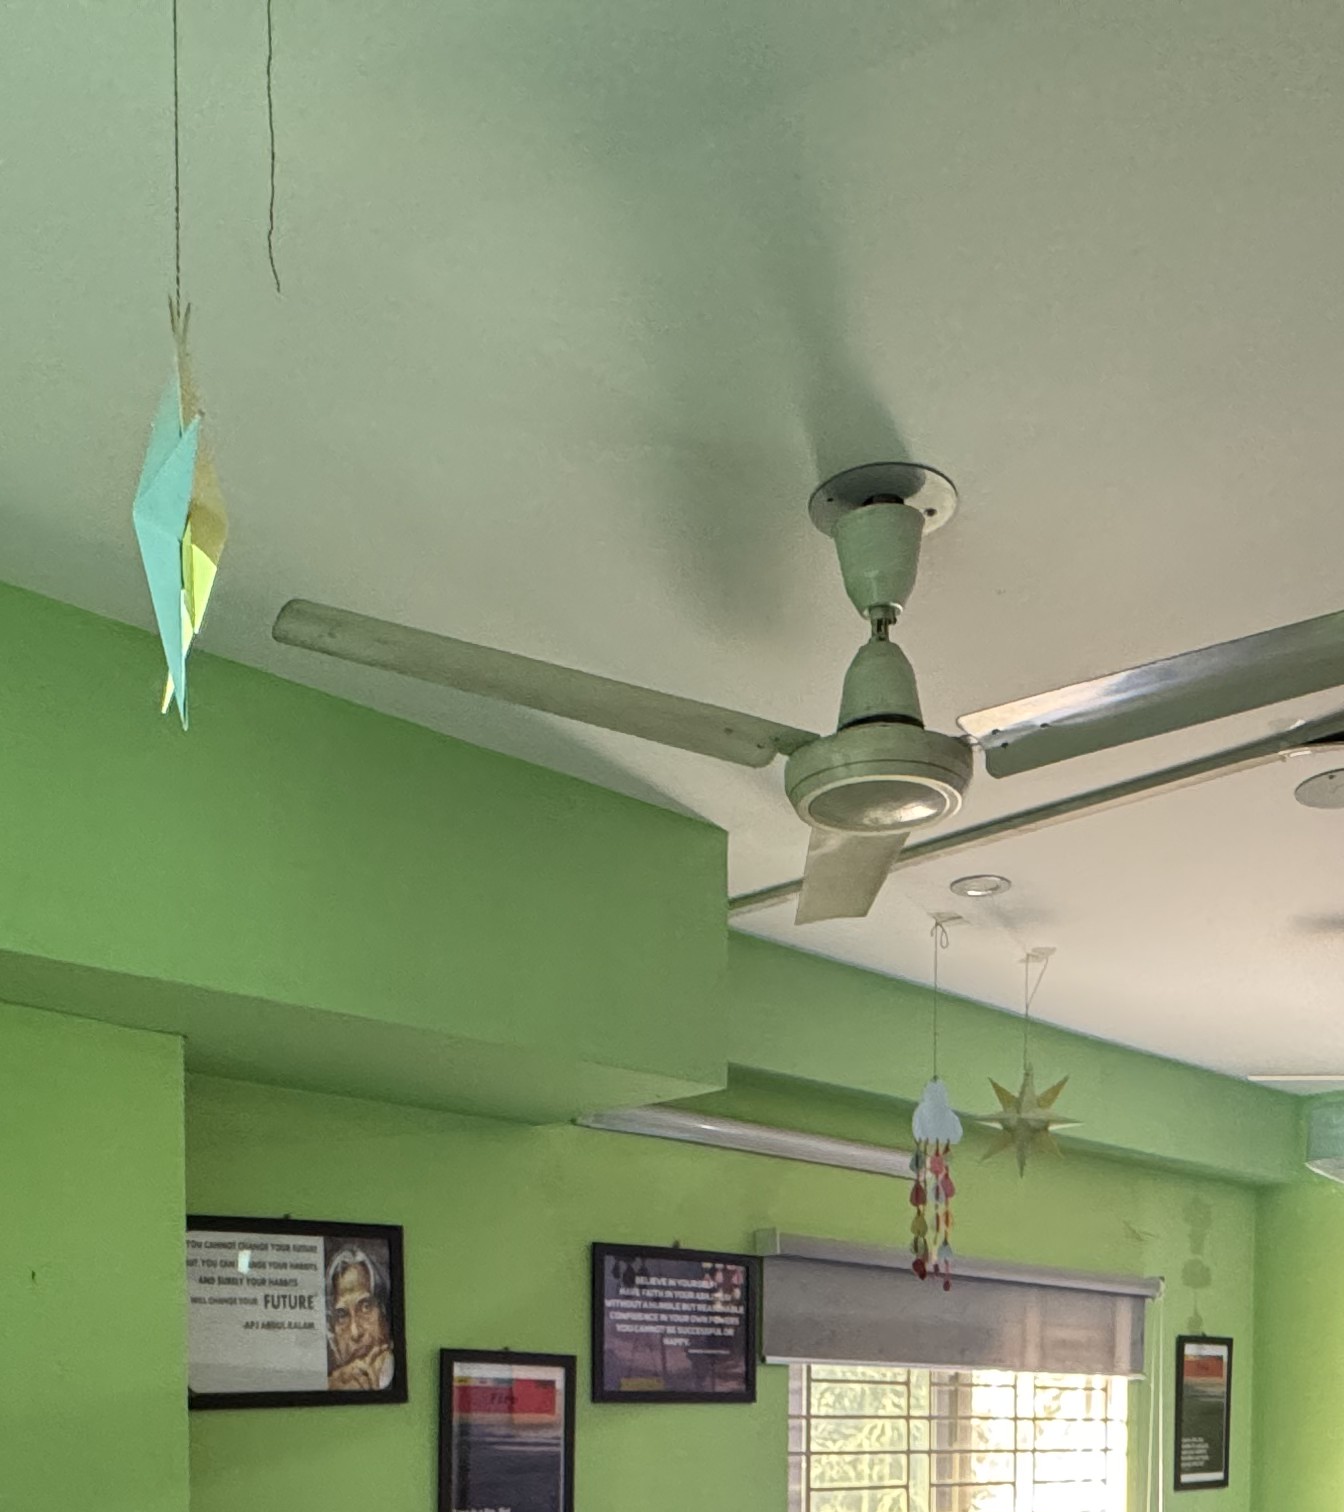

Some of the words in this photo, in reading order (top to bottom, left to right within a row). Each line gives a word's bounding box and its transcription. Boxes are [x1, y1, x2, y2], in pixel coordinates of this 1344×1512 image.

[198, 1276, 216, 1286] AND
[217, 1276, 244, 1287] SURELY
[246, 1277, 267, 1287] YOUR
[635, 1275, 668, 1287] BELIEVE
[668, 1277, 677, 1287] IN
[619, 1287, 640, 1298] HAVE
[641, 1288, 664, 1299] FAITH
[674, 1290, 695, 1300] YOUR
[263, 1294, 315, 1311] FUTURE
[604, 1298, 642, 1309] WITHOUT
[648, 1301, 681, 1311] HUMBLE
[681, 1302, 696, 1312] BUT
[608, 1311, 659, 1322] CONFIDENCE
[669, 1313, 690, 1323] YOUR
[690, 1314, 709, 1324] OWN
[709, 1315, 740, 1326] POWERS
[615, 1323, 634, 1333] YOU
[634, 1323, 665, 1334] CANNOT
[666, 1325, 677, 1335] BE
[677, 1325, 722, 1336] SUCCESSFUL
